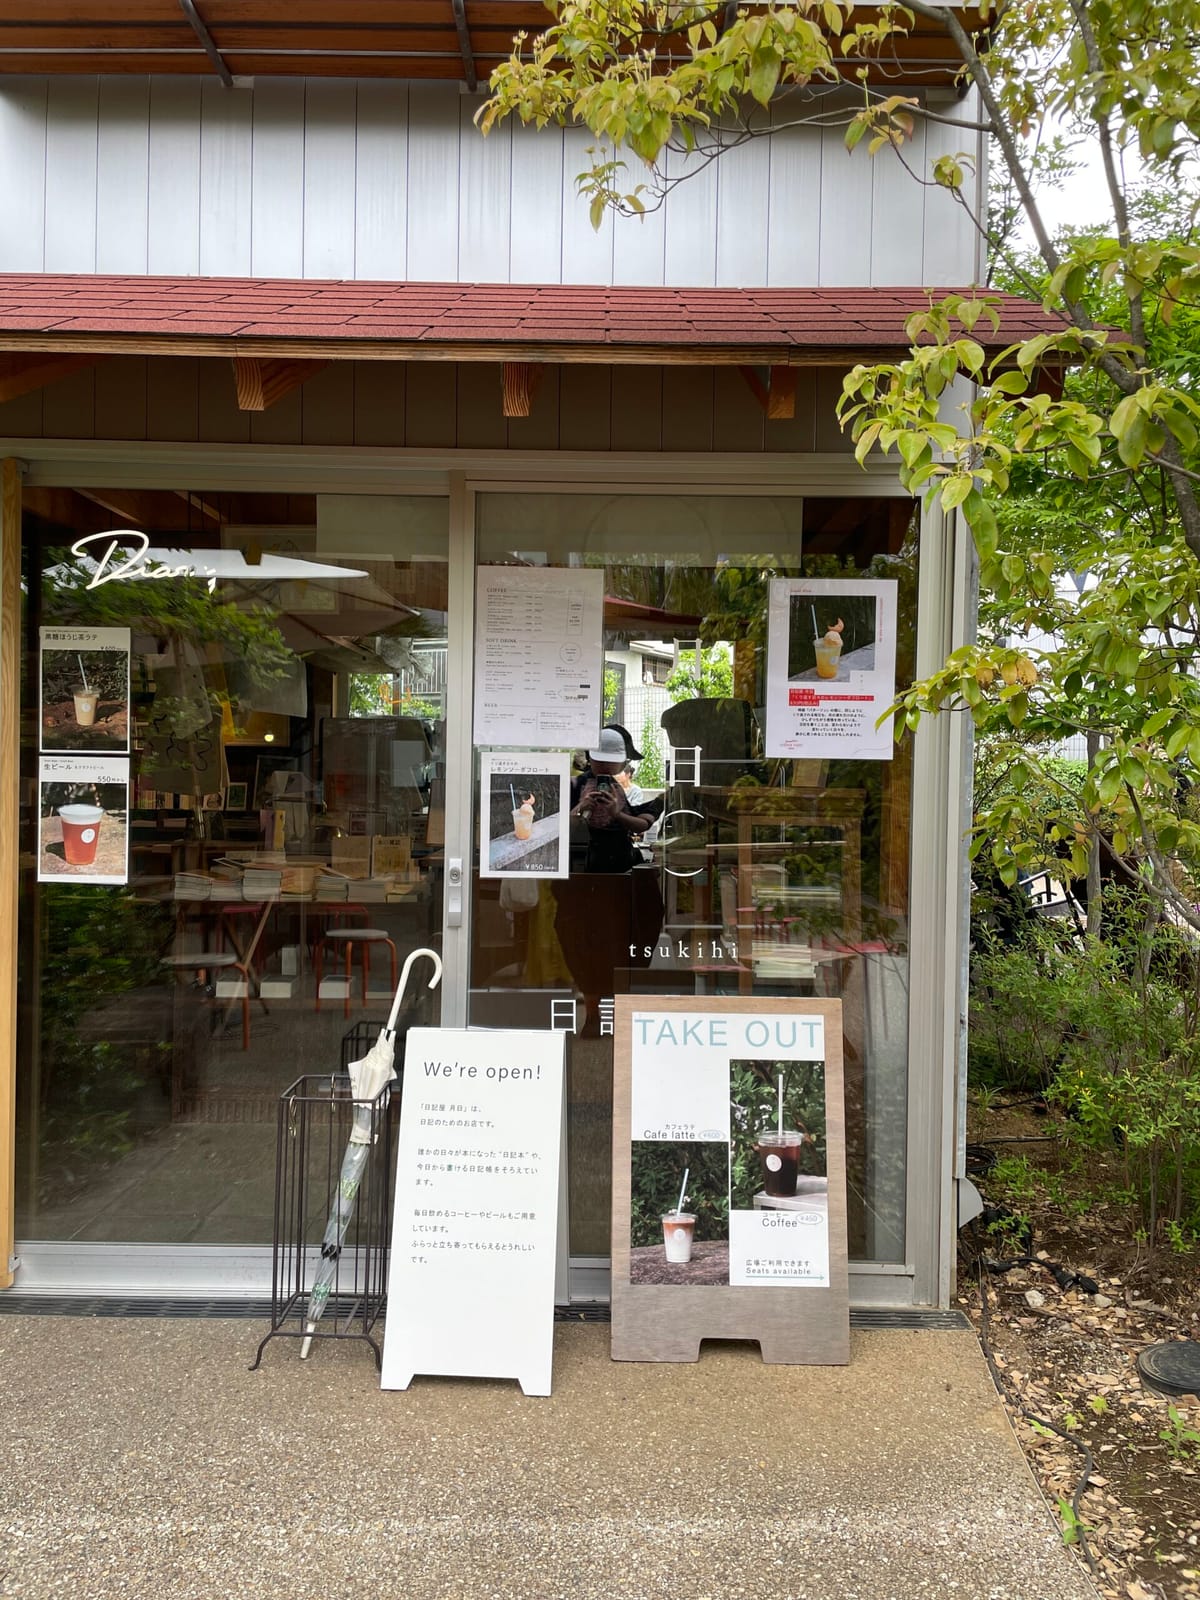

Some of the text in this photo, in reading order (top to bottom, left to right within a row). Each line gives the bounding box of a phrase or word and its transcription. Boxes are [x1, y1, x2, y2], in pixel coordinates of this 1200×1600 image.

[44, 763, 73, 771] 生ビール
[628, 940, 738, 959] tsukihi
[633, 1019, 822, 1049] TAKE OUT
[486, 1064, 541, 1083] open!
[420, 1118, 495, 1129] 日記のためのお店です。
[643, 1129, 668, 1140] Cafe
[671, 1130, 696, 1140] latte
[415, 1178, 434, 1187] ます。
[761, 1217, 798, 1228] Coffee
[411, 1224, 449, 1233] しています。
[410, 1256, 428, 1264] です。
[745, 1266, 812, 1275] Seats available
